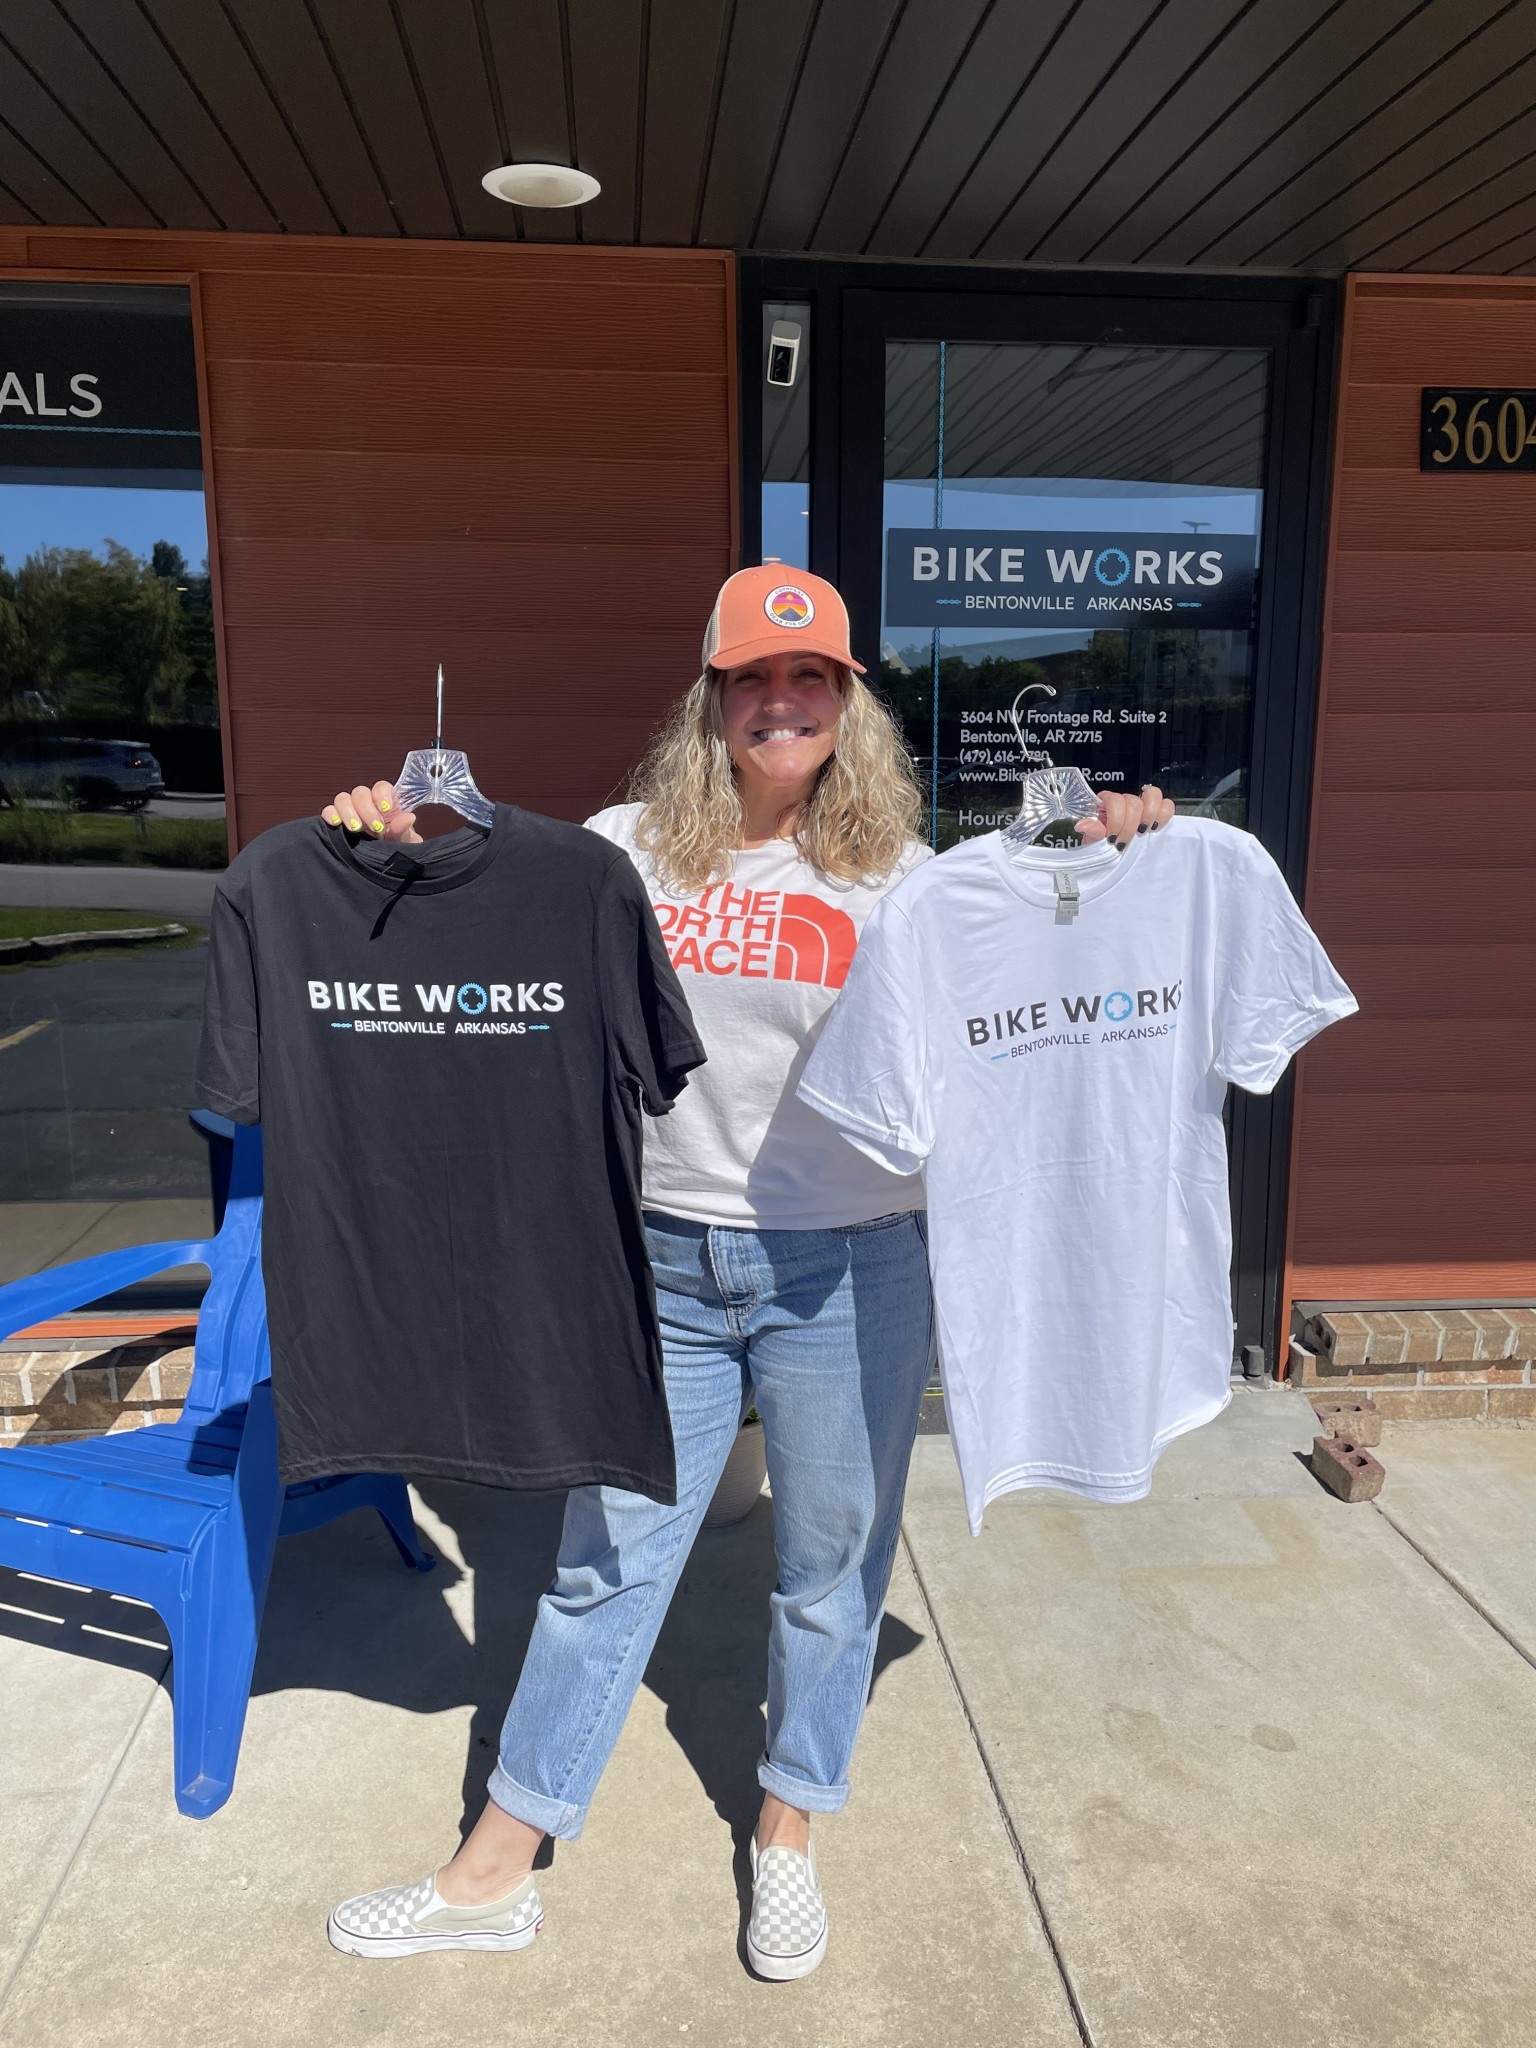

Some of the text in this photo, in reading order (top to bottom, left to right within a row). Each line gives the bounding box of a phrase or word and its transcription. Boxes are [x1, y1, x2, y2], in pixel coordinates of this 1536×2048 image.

[912, 546, 1224, 587] BIKE WORKS
[965, 595, 1173, 612] BENTONVILLE ARKANSAS
[960, 709, 1167, 727] 3604 NW Frontage Rd. Suite 2
[1044, 730, 1065, 743] AR
[1068, 730, 1103, 743] 72715
[959, 749, 991, 764] (479)
[699, 881, 780, 916] THE
[653, 903, 776, 941] ORTH
[307, 980, 565, 1015] BIKE WORKS
[966, 979, 1182, 1047] BIKE WORK
[354, 1020, 526, 1035] BENTONVILLE ARKANSAS
[1011, 1024, 1168, 1058] BENTONVILLE ARKANSAS
